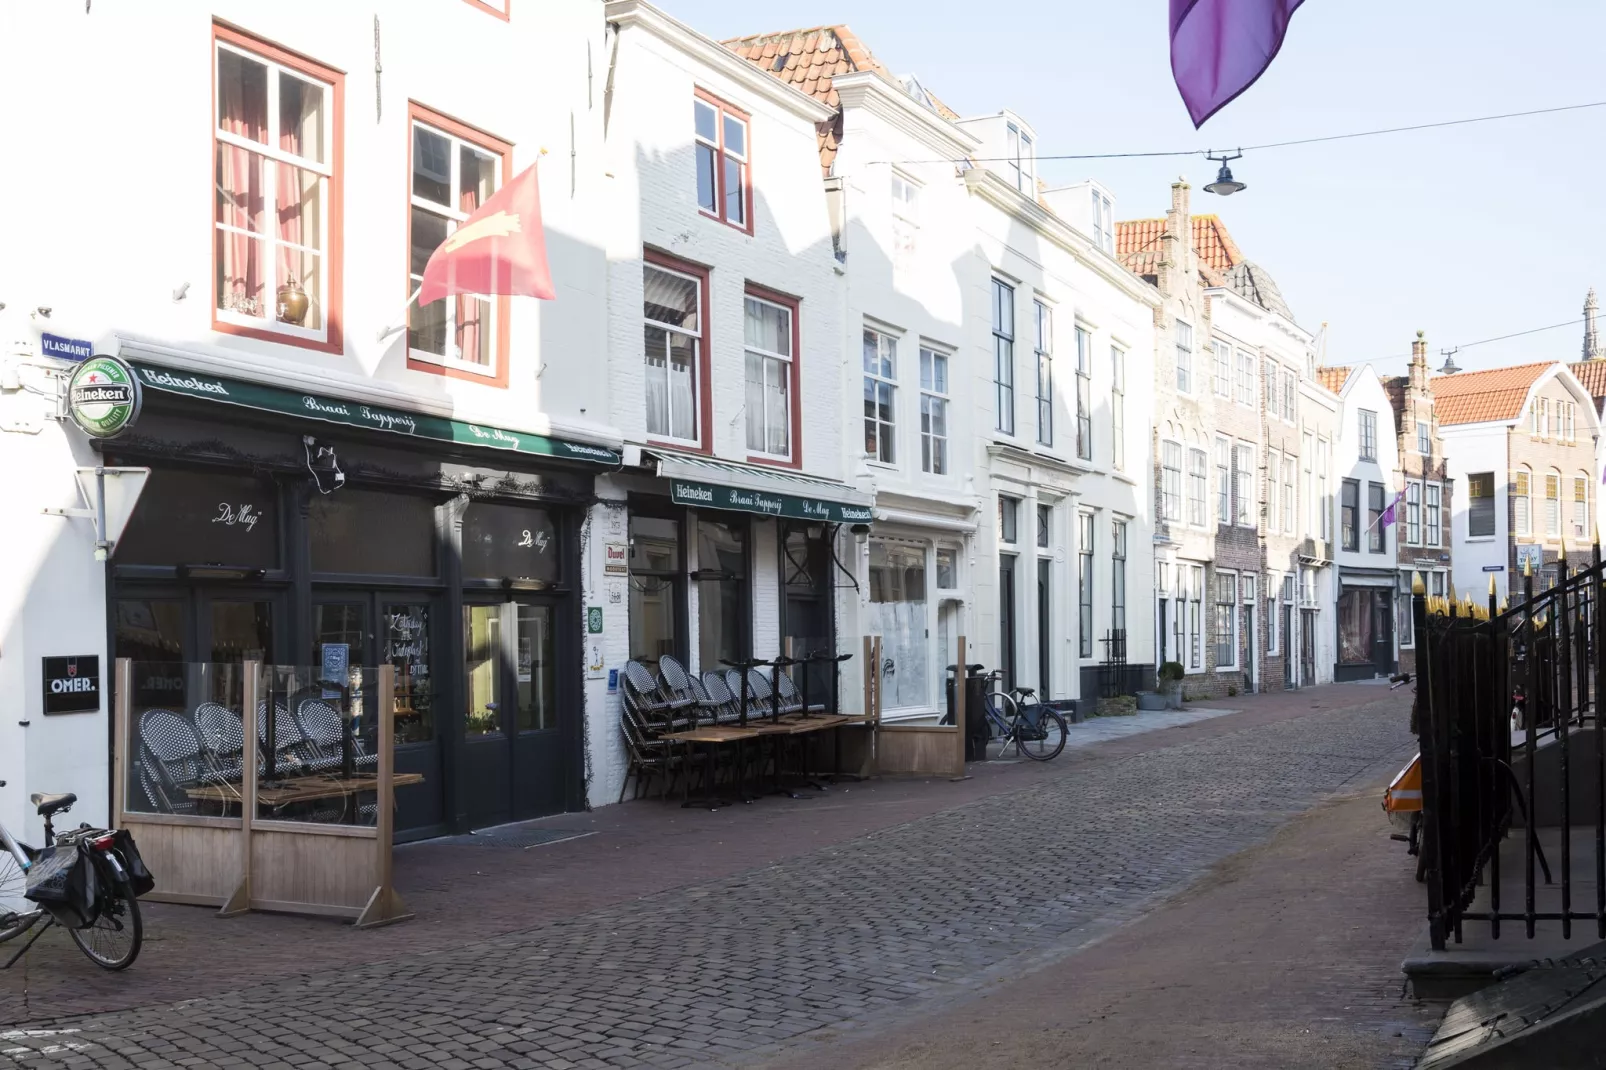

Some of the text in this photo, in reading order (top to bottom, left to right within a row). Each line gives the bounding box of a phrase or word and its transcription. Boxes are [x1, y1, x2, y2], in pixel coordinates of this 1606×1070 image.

[43, 339, 91, 356] VLASMARKT
[141, 368, 229, 395] Heineken
[100, 408, 122, 427] QUALITY
[469, 425, 490, 438] De
[676, 484, 713, 501] Heineken
[802, 499, 812, 513] De
[608, 546, 625, 559] Duvel
